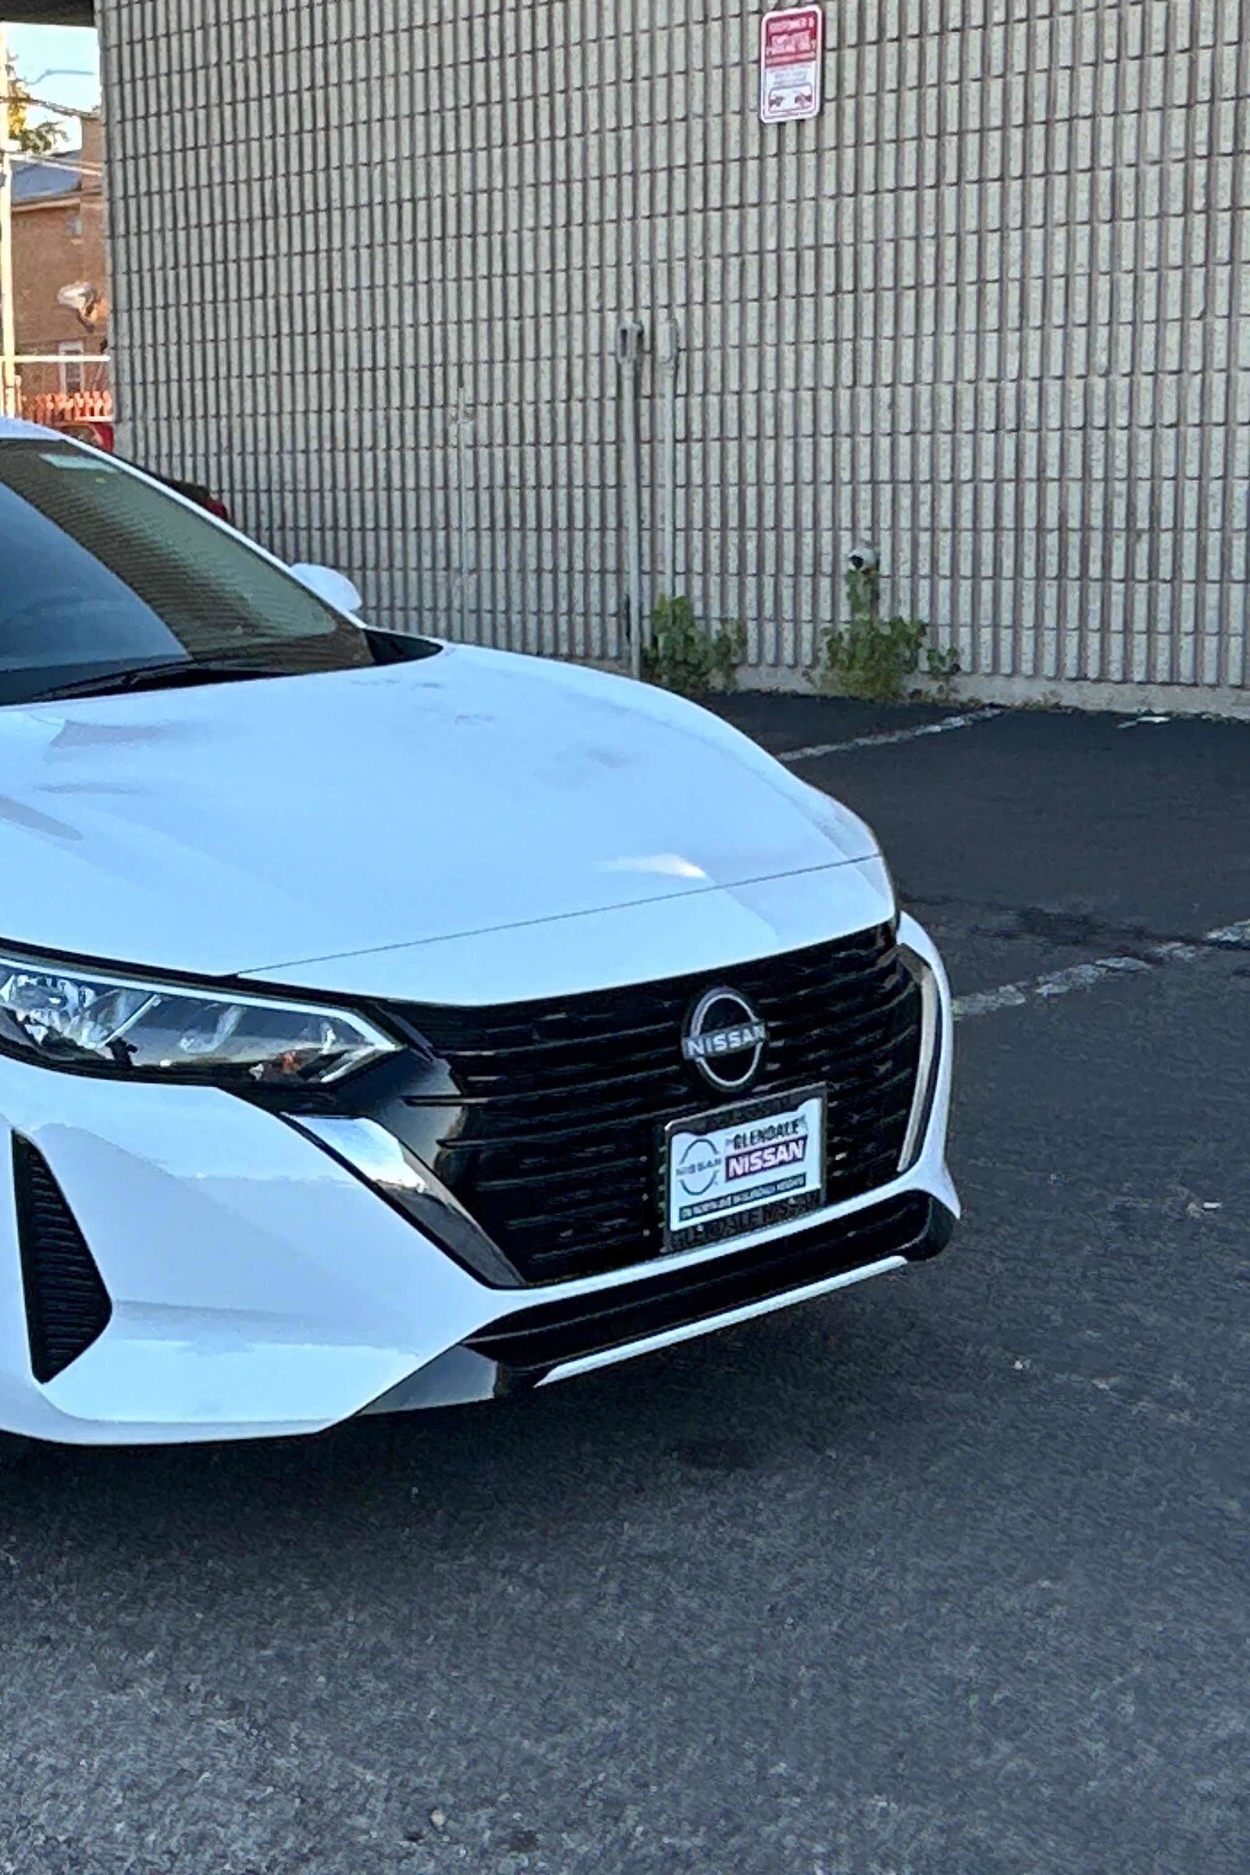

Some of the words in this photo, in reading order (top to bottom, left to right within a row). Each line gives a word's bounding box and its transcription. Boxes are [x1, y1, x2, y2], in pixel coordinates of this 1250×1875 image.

[687, 1023, 765, 1056] NISSAN
[733, 1120, 800, 1150] GLENDALE
[727, 1139, 805, 1178] NISSAN
